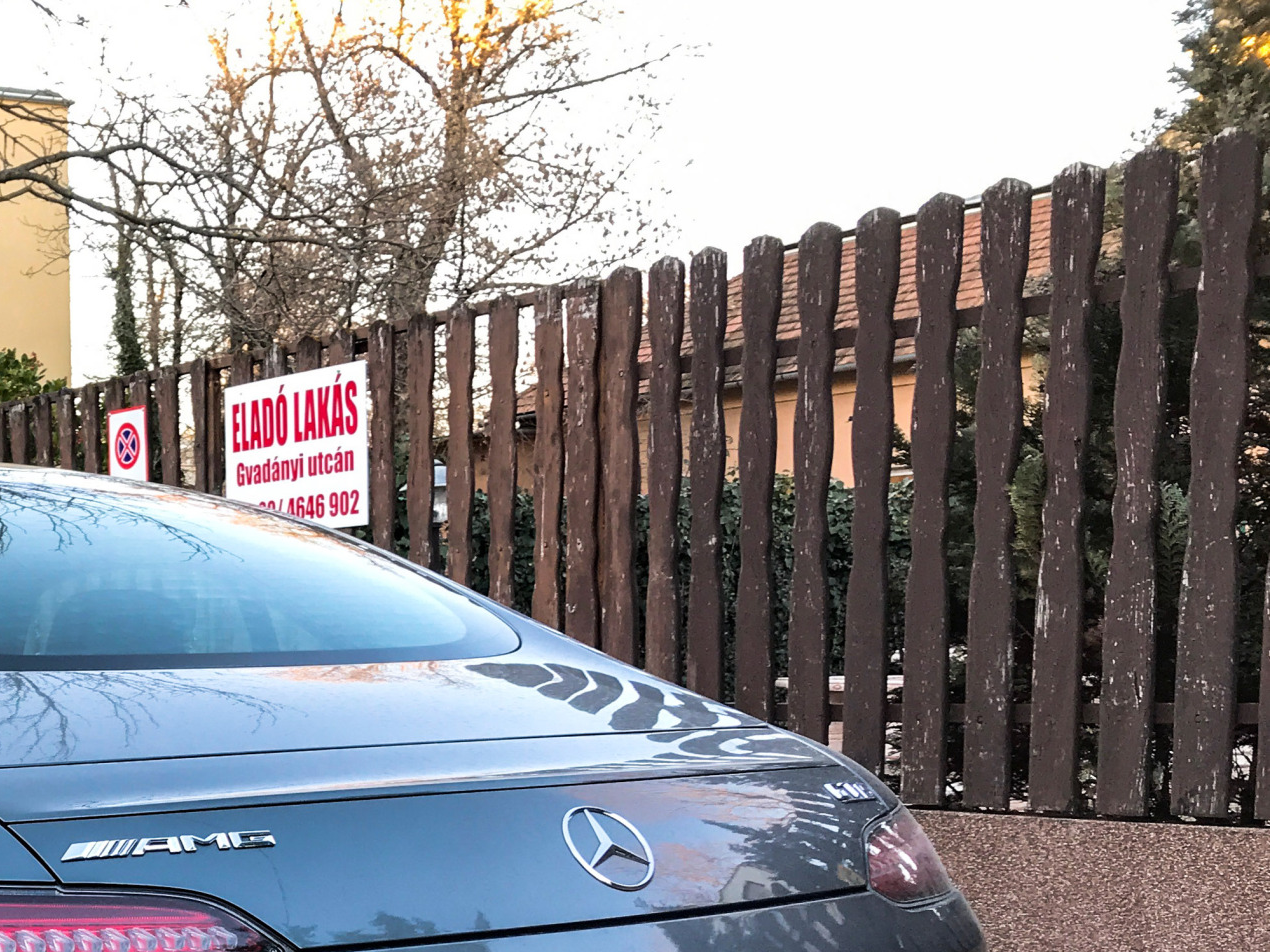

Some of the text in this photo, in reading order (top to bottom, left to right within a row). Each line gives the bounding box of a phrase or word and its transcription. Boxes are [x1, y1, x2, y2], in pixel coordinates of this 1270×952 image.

[232, 373, 358, 453] ELADÓ LAKÁS
[236, 446, 354, 487] Gvadányi utcán
[287, 493, 325, 519] 4646
[329, 489, 359, 517] 902
[132, 830, 276, 856] AMG
